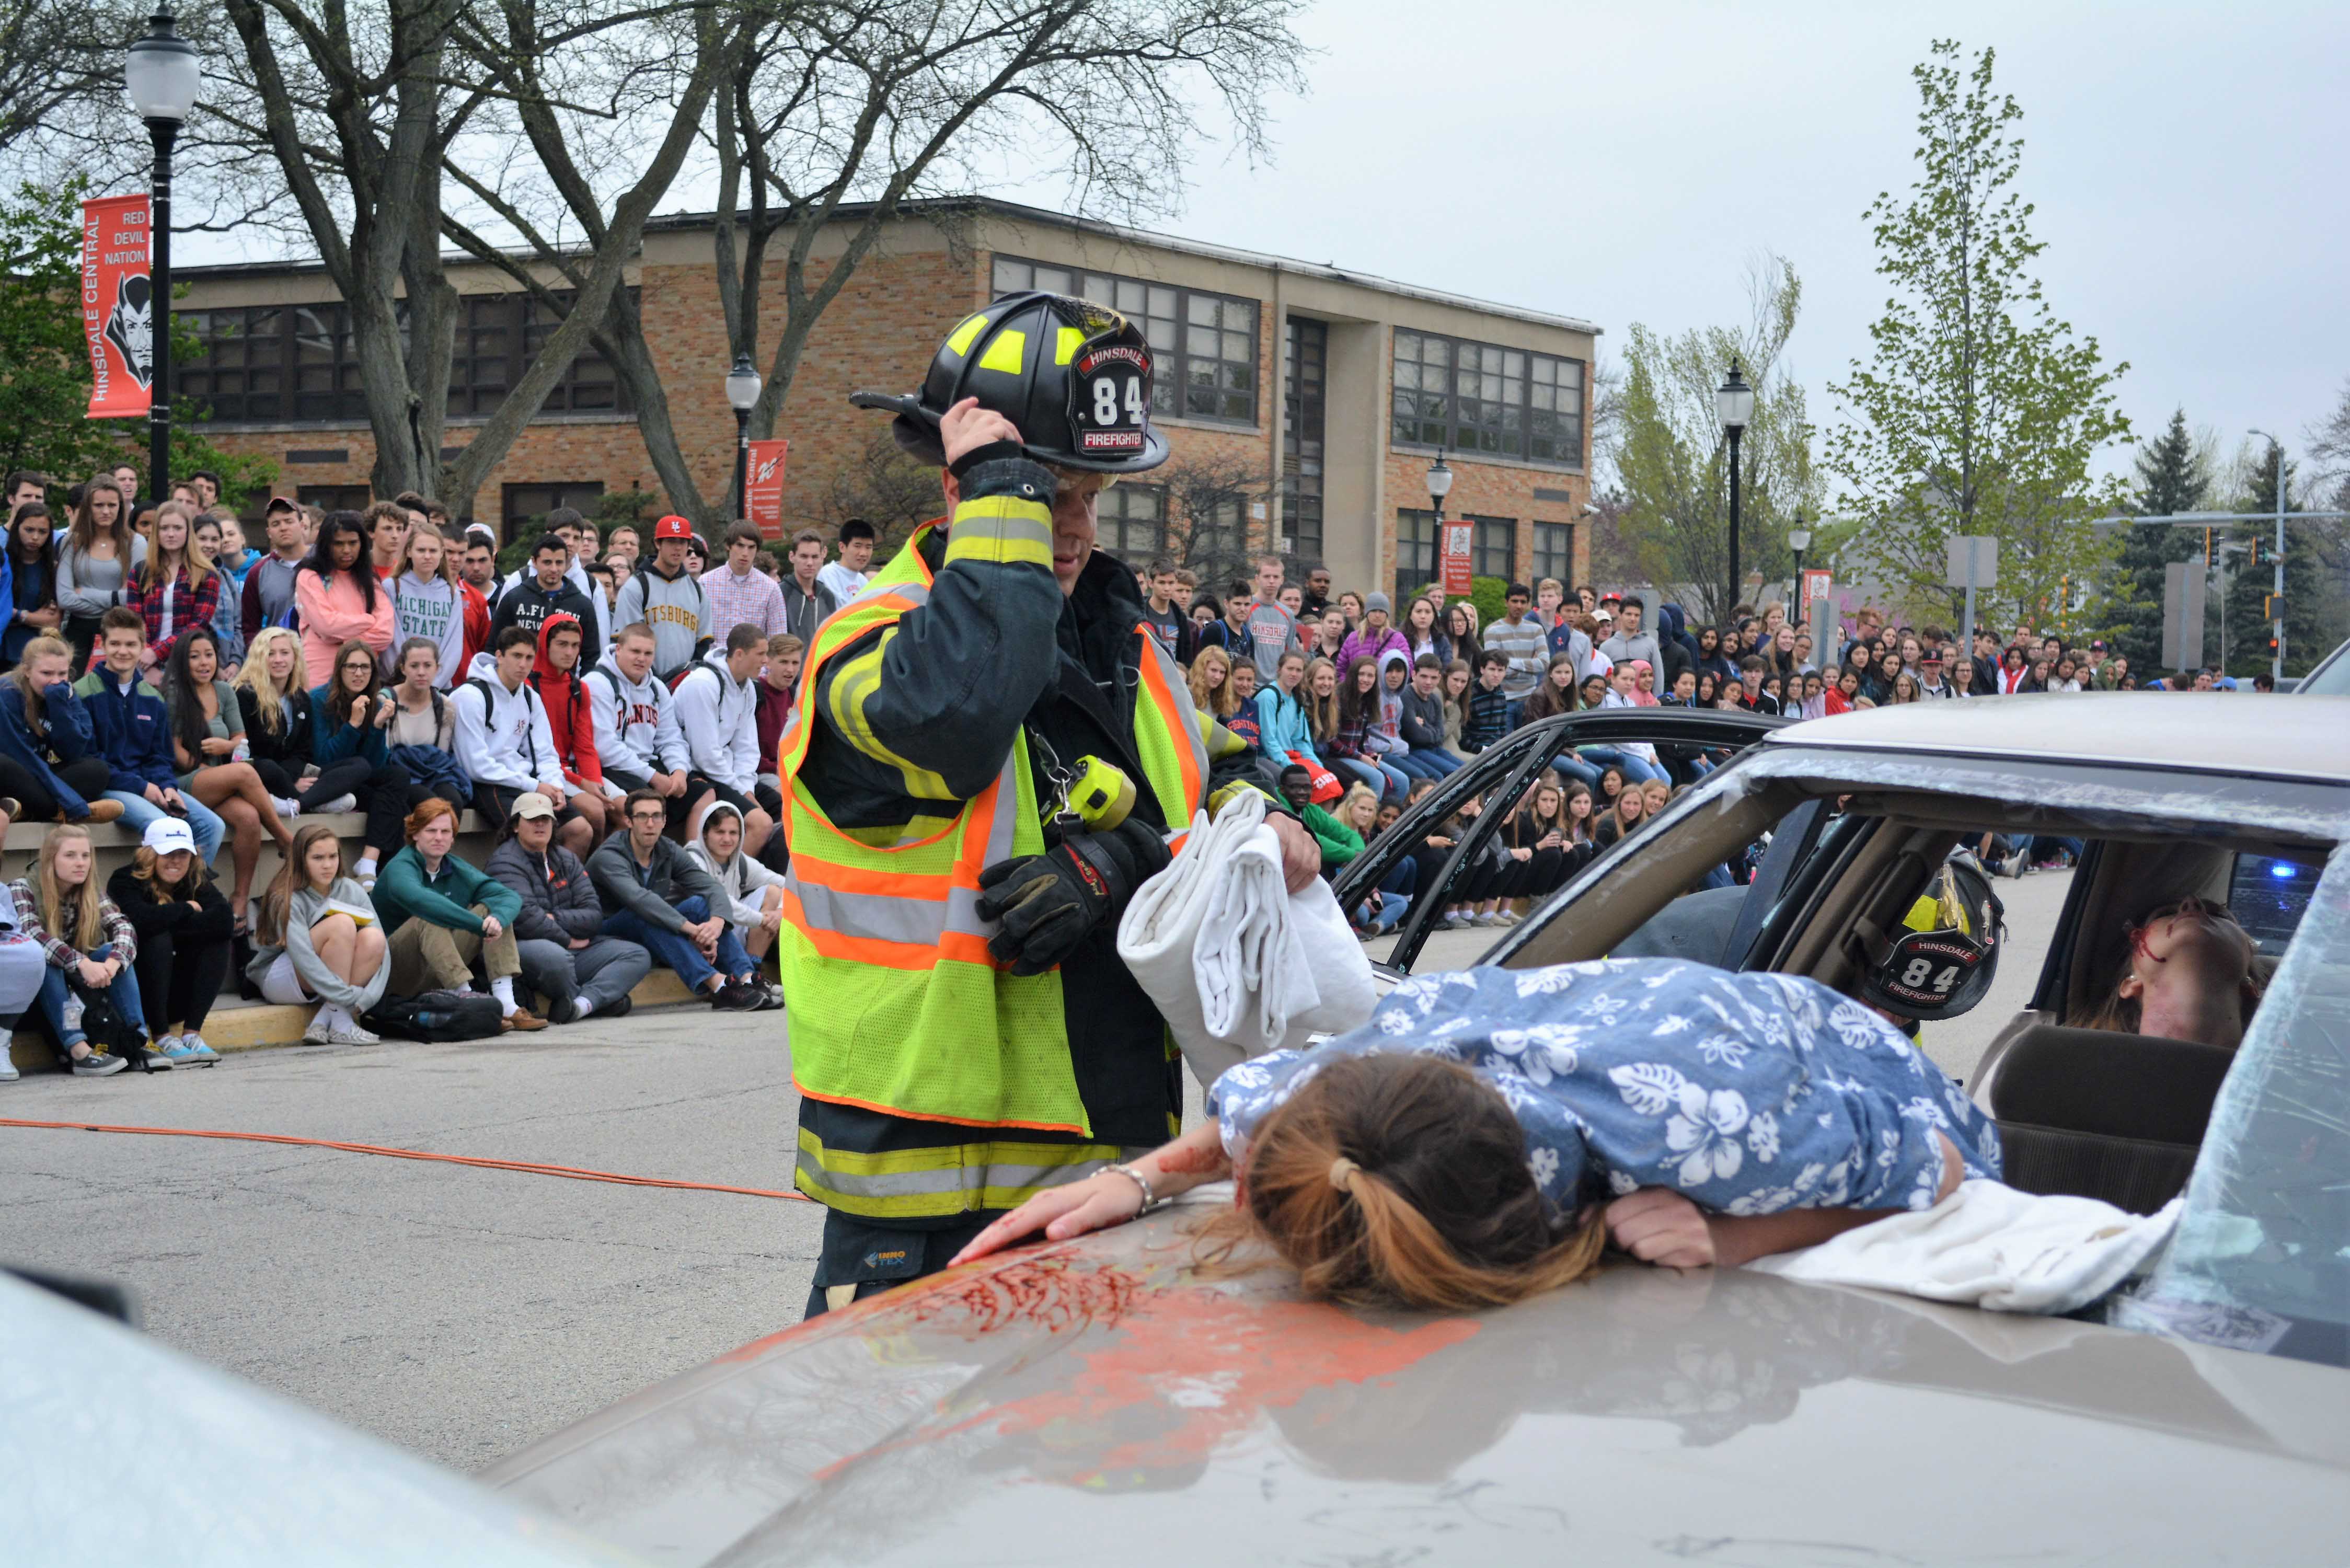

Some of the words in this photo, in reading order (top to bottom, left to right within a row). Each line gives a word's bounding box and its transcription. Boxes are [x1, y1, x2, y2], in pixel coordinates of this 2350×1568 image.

[123, 211, 146, 225] RED
[114, 231, 146, 245] DEVIL
[85, 214, 99, 304] CENTRAL
[105, 250, 146, 265] NATION
[86, 309, 109, 402] HINSDALE
[1089, 347, 1143, 366] HINSDALE
[1093, 376, 1143, 426] 84
[1085, 432, 1142, 446] FIREFIGHTER
[746, 448, 757, 486] Central
[402, 615, 446, 637] STATE
[1918, 942, 1973, 960] HINSDALE
[1901, 958, 1960, 993] 84
[1888, 981, 1947, 1001] FIREFIGHTER
